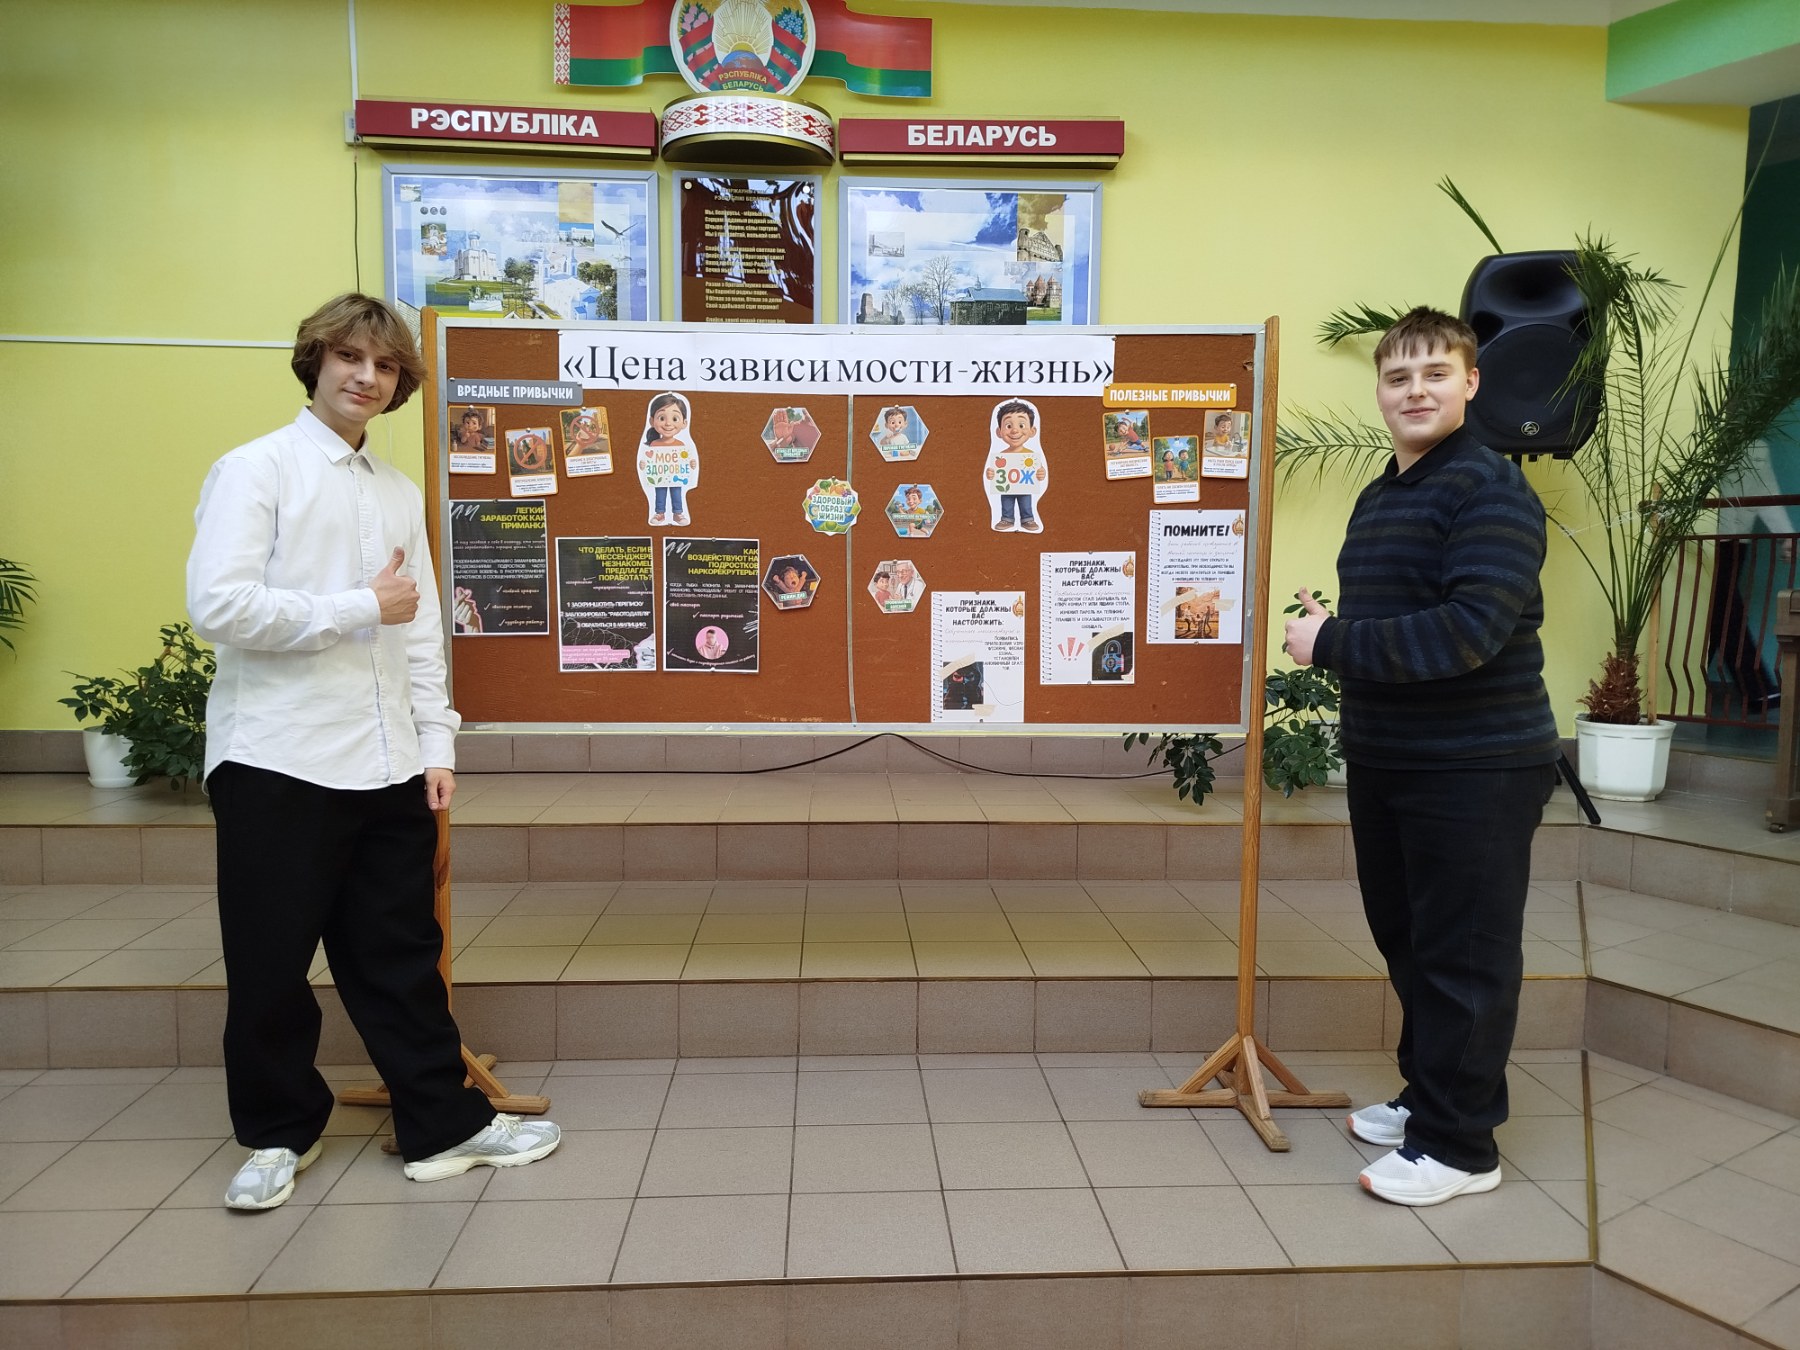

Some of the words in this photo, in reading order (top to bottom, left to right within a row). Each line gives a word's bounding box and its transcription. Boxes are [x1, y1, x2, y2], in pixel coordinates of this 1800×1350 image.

[718, 70, 767, 84] РЭСПУБЛІКА
[722, 80, 764, 92] БЕЛАРУСЬ
[411, 108, 599, 137] РЭСПУБЛІКА
[908, 125, 1057, 147] БЕЛАРУСЬ
[564, 346, 687, 388] «Цена
[457, 384, 510, 398] ВРЕДНЫЕ
[512, 386, 573, 400] ПРИВЫЧКИ
[1110, 390, 1168, 401] ПОЛЕЗНЫЕ
[1171, 390, 1230, 402] ПРИВЫЧКИ
[646, 464, 690, 476] ЗДОРОВЬЕ
[996, 468, 1036, 485] ЗОЖ
[812, 496, 852, 506] ЗДОРОВЫЙ
[820, 504, 843, 513] ОБРАЗ
[818, 512, 844, 521] ЖИЗНИ
[1164, 525, 1230, 536] ПОМНИТЕ!
[688, 554, 746, 562] ВОЗДЕЙСТВУЮТ
